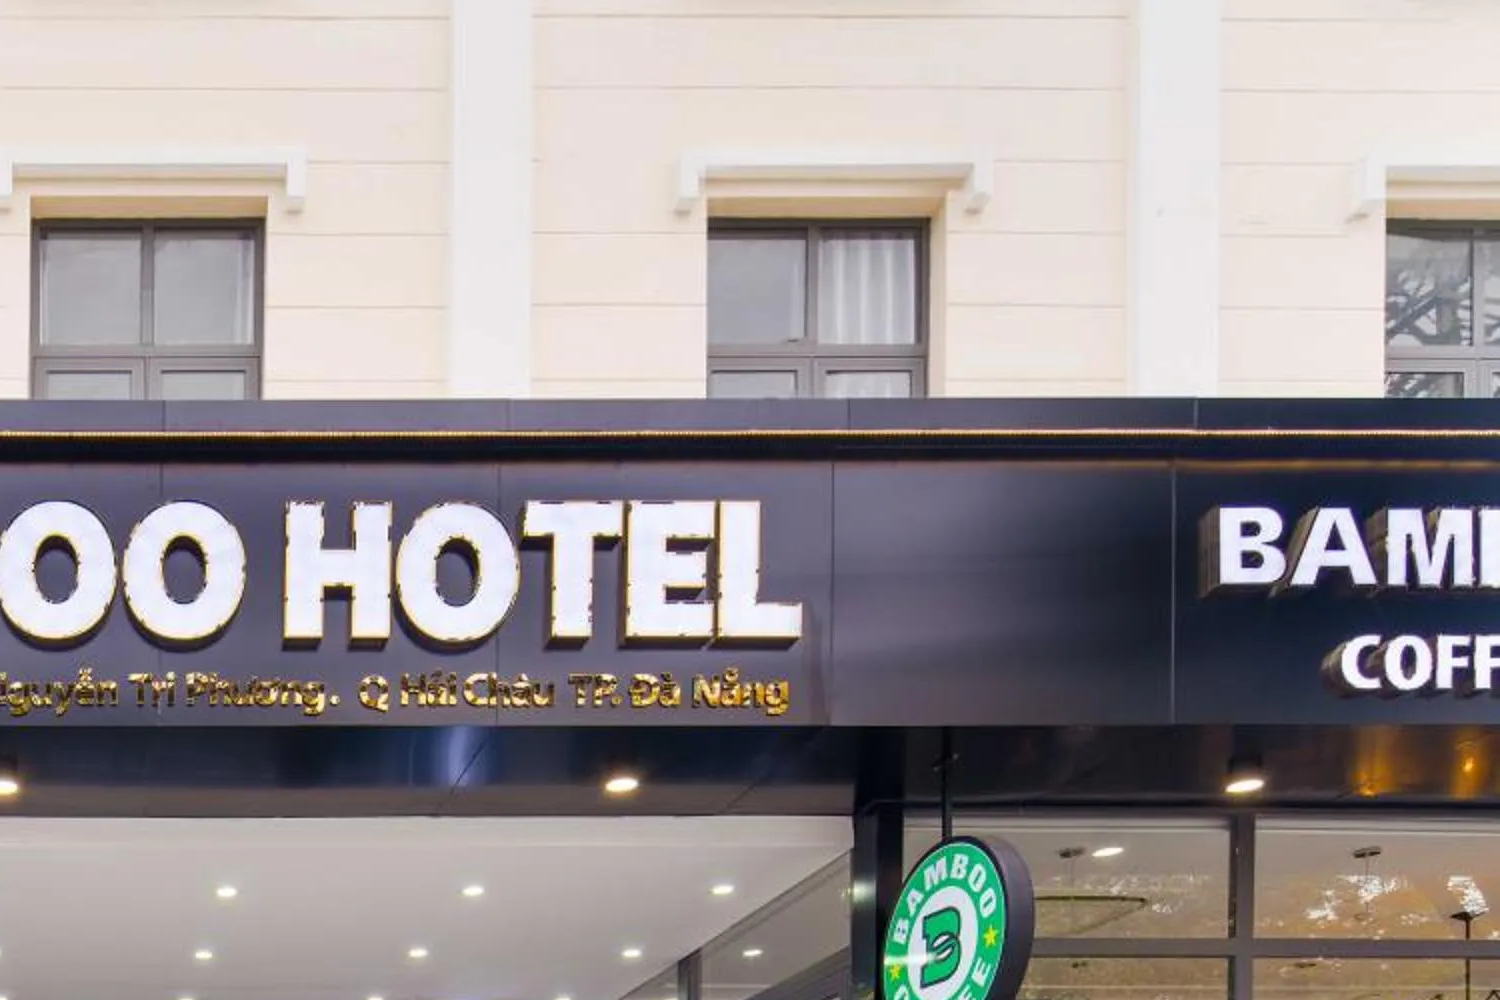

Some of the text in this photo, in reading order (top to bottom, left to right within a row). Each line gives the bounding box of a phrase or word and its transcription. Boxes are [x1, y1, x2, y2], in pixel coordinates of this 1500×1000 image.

[282, 498, 803, 648] HOTEL
[359, 674, 389, 712] Q
[463, 671, 554, 708] Châu
[894, 853, 997, 944] BAMBOO
